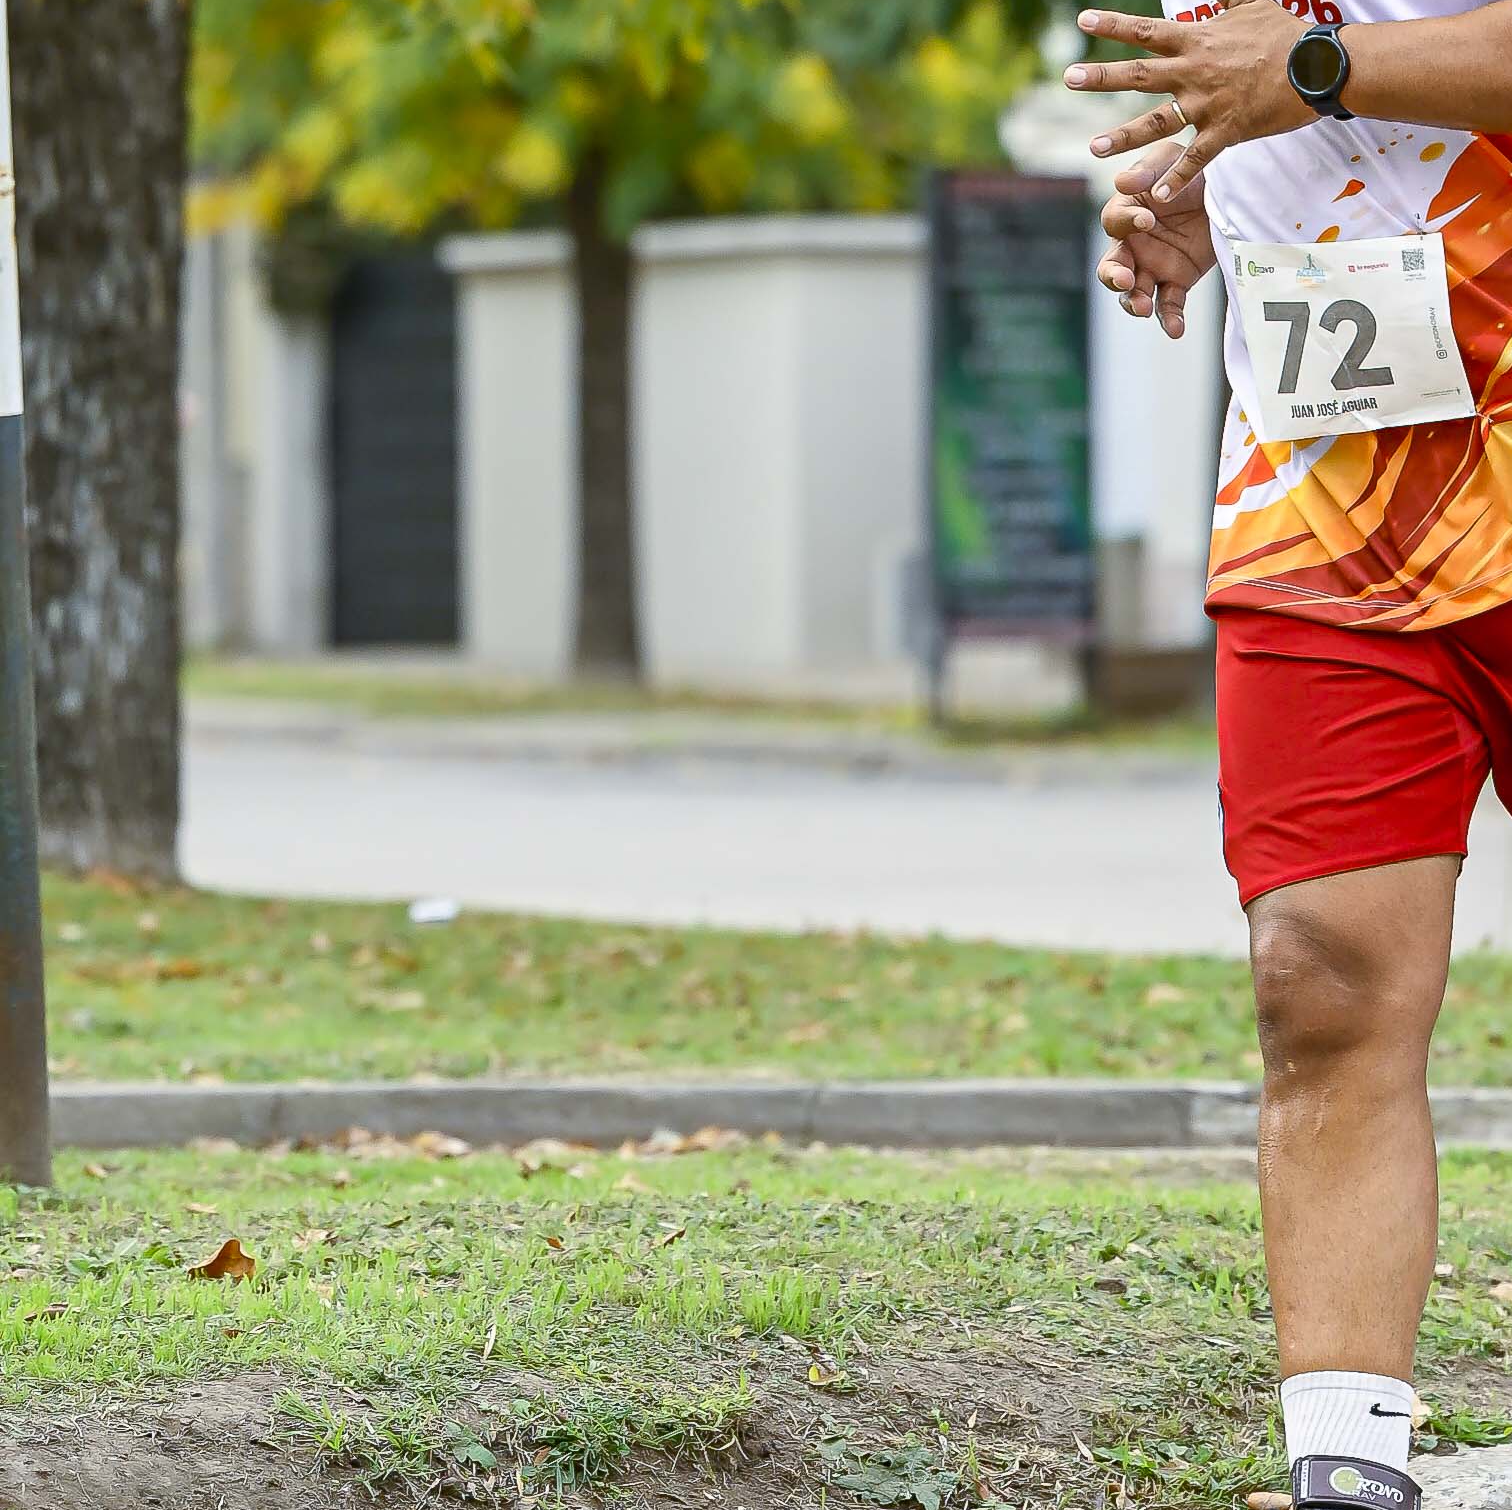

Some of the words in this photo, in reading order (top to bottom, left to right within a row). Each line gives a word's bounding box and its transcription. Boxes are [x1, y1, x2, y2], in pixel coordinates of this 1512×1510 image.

[1263, 299, 1394, 394] 72
[1291, 404, 1315, 418] JUAN
[1317, 399, 1341, 417] JOSÉ
[1341, 397, 1378, 414] AGUIAR
